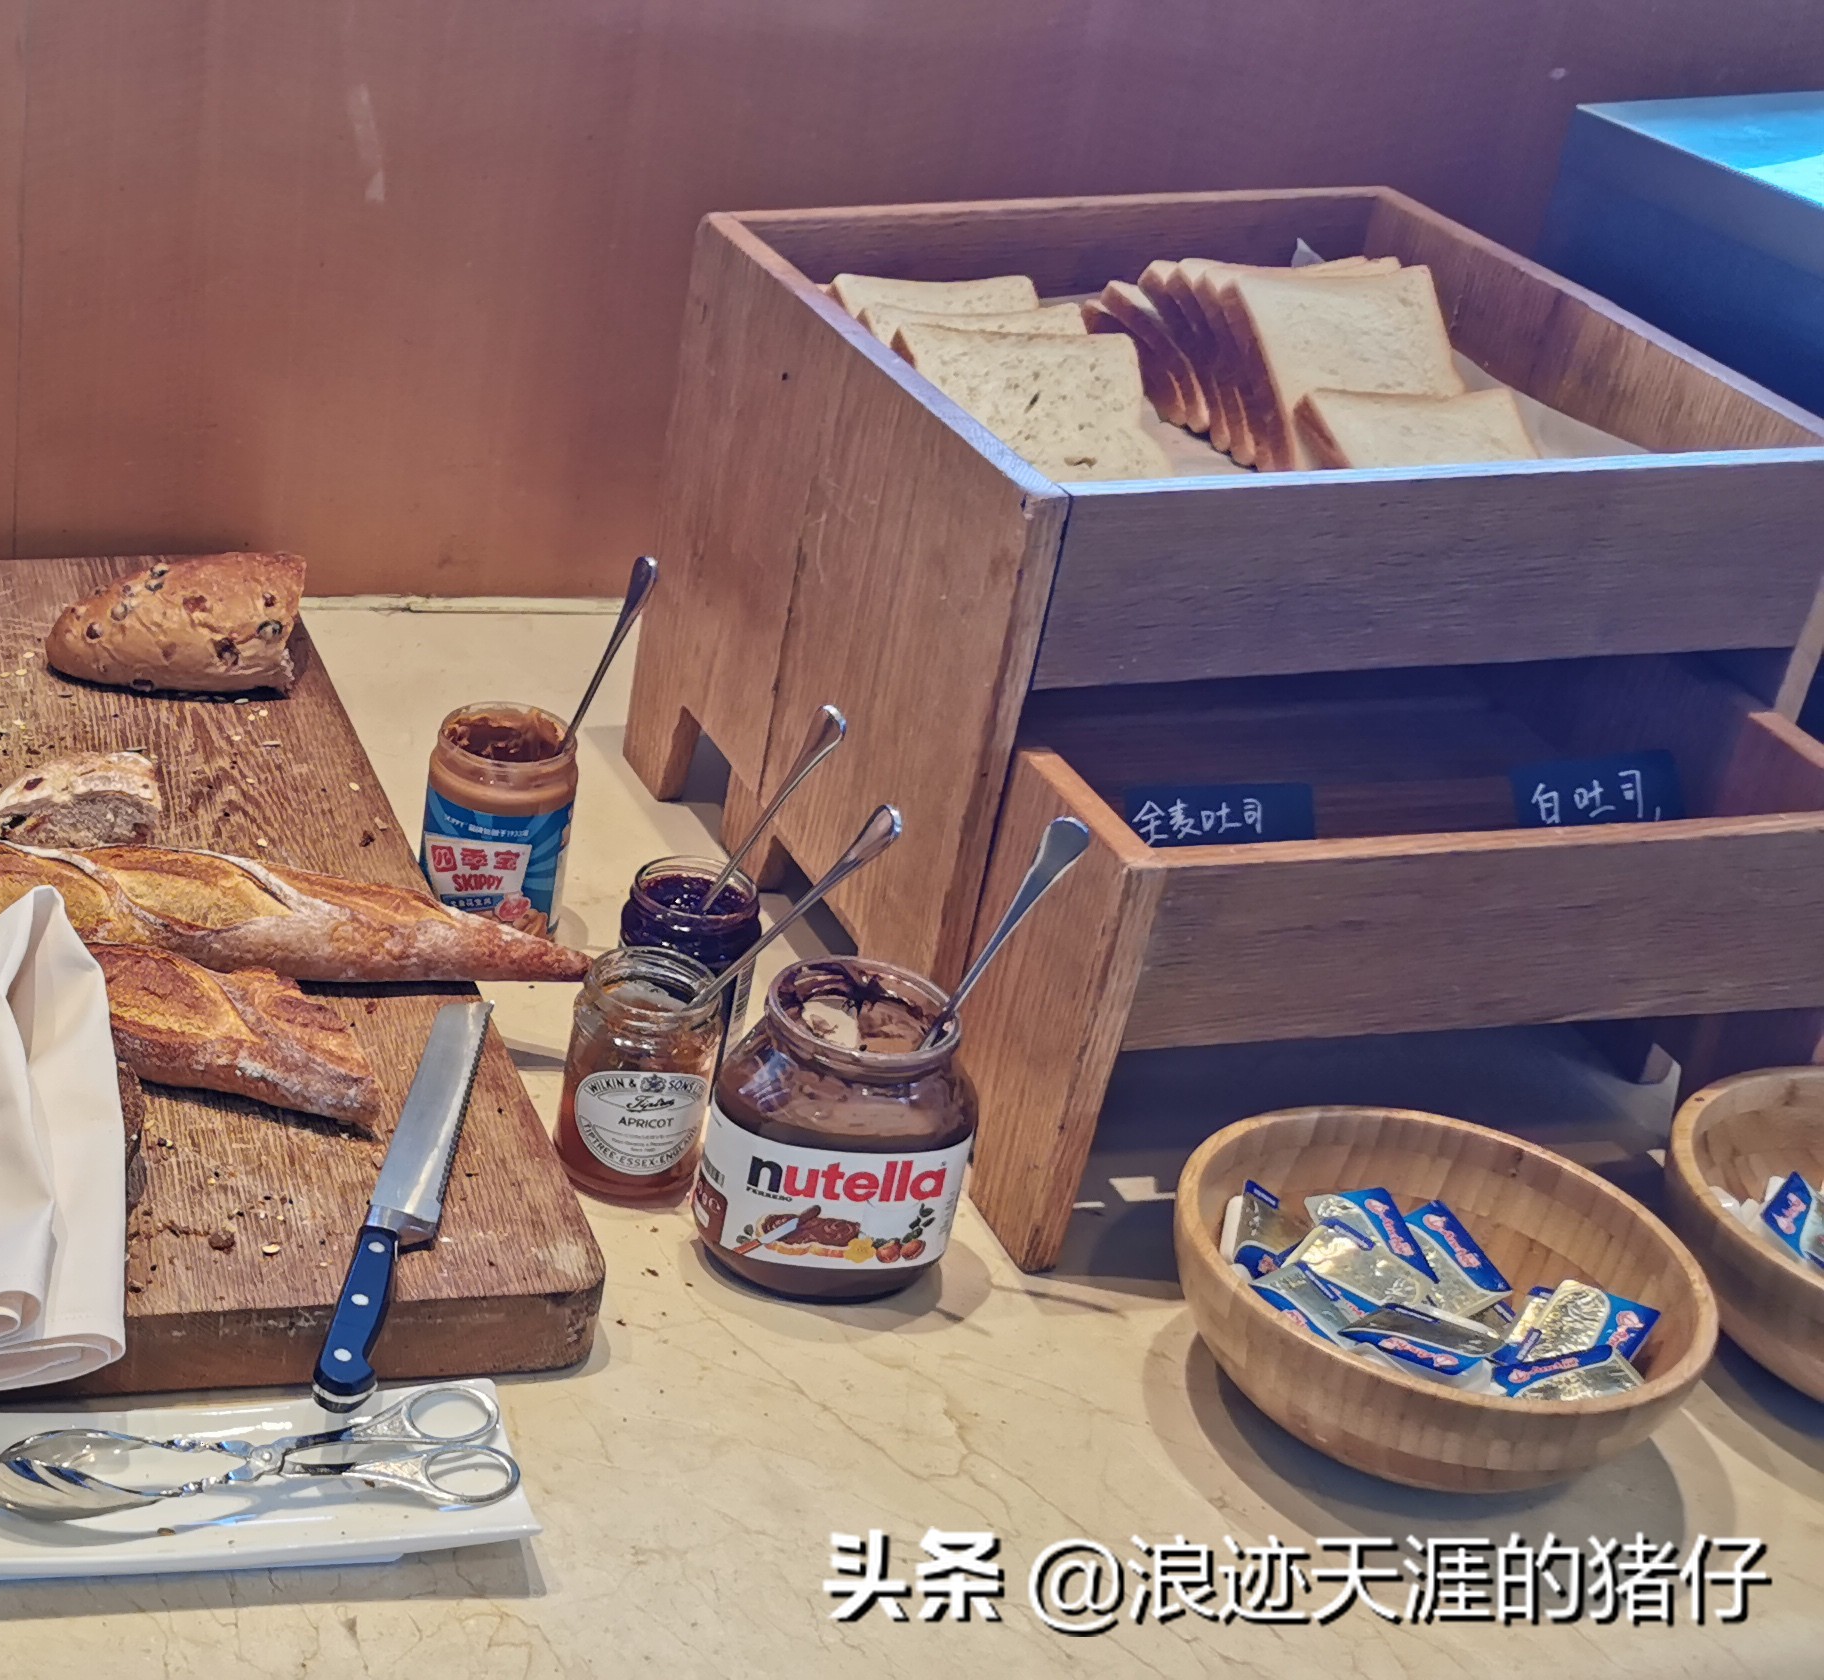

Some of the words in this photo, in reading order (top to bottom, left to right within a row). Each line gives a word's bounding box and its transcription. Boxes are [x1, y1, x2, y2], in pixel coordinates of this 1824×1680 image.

[1531, 770, 1644, 824] 白吐司
[1132, 798, 1262, 846] 全麦吐司
[452, 874, 504, 892] SKIPPY
[588, 1078, 624, 1094] WILKIN
[629, 1079, 637, 1089] &
[669, 1080, 695, 1094] SONS
[584, 1122, 614, 1159] TIPTREE
[619, 1157, 655, 1167] ESSEX
[618, 1116, 674, 1129] APRICOT
[746, 1155, 948, 1202] nutella
